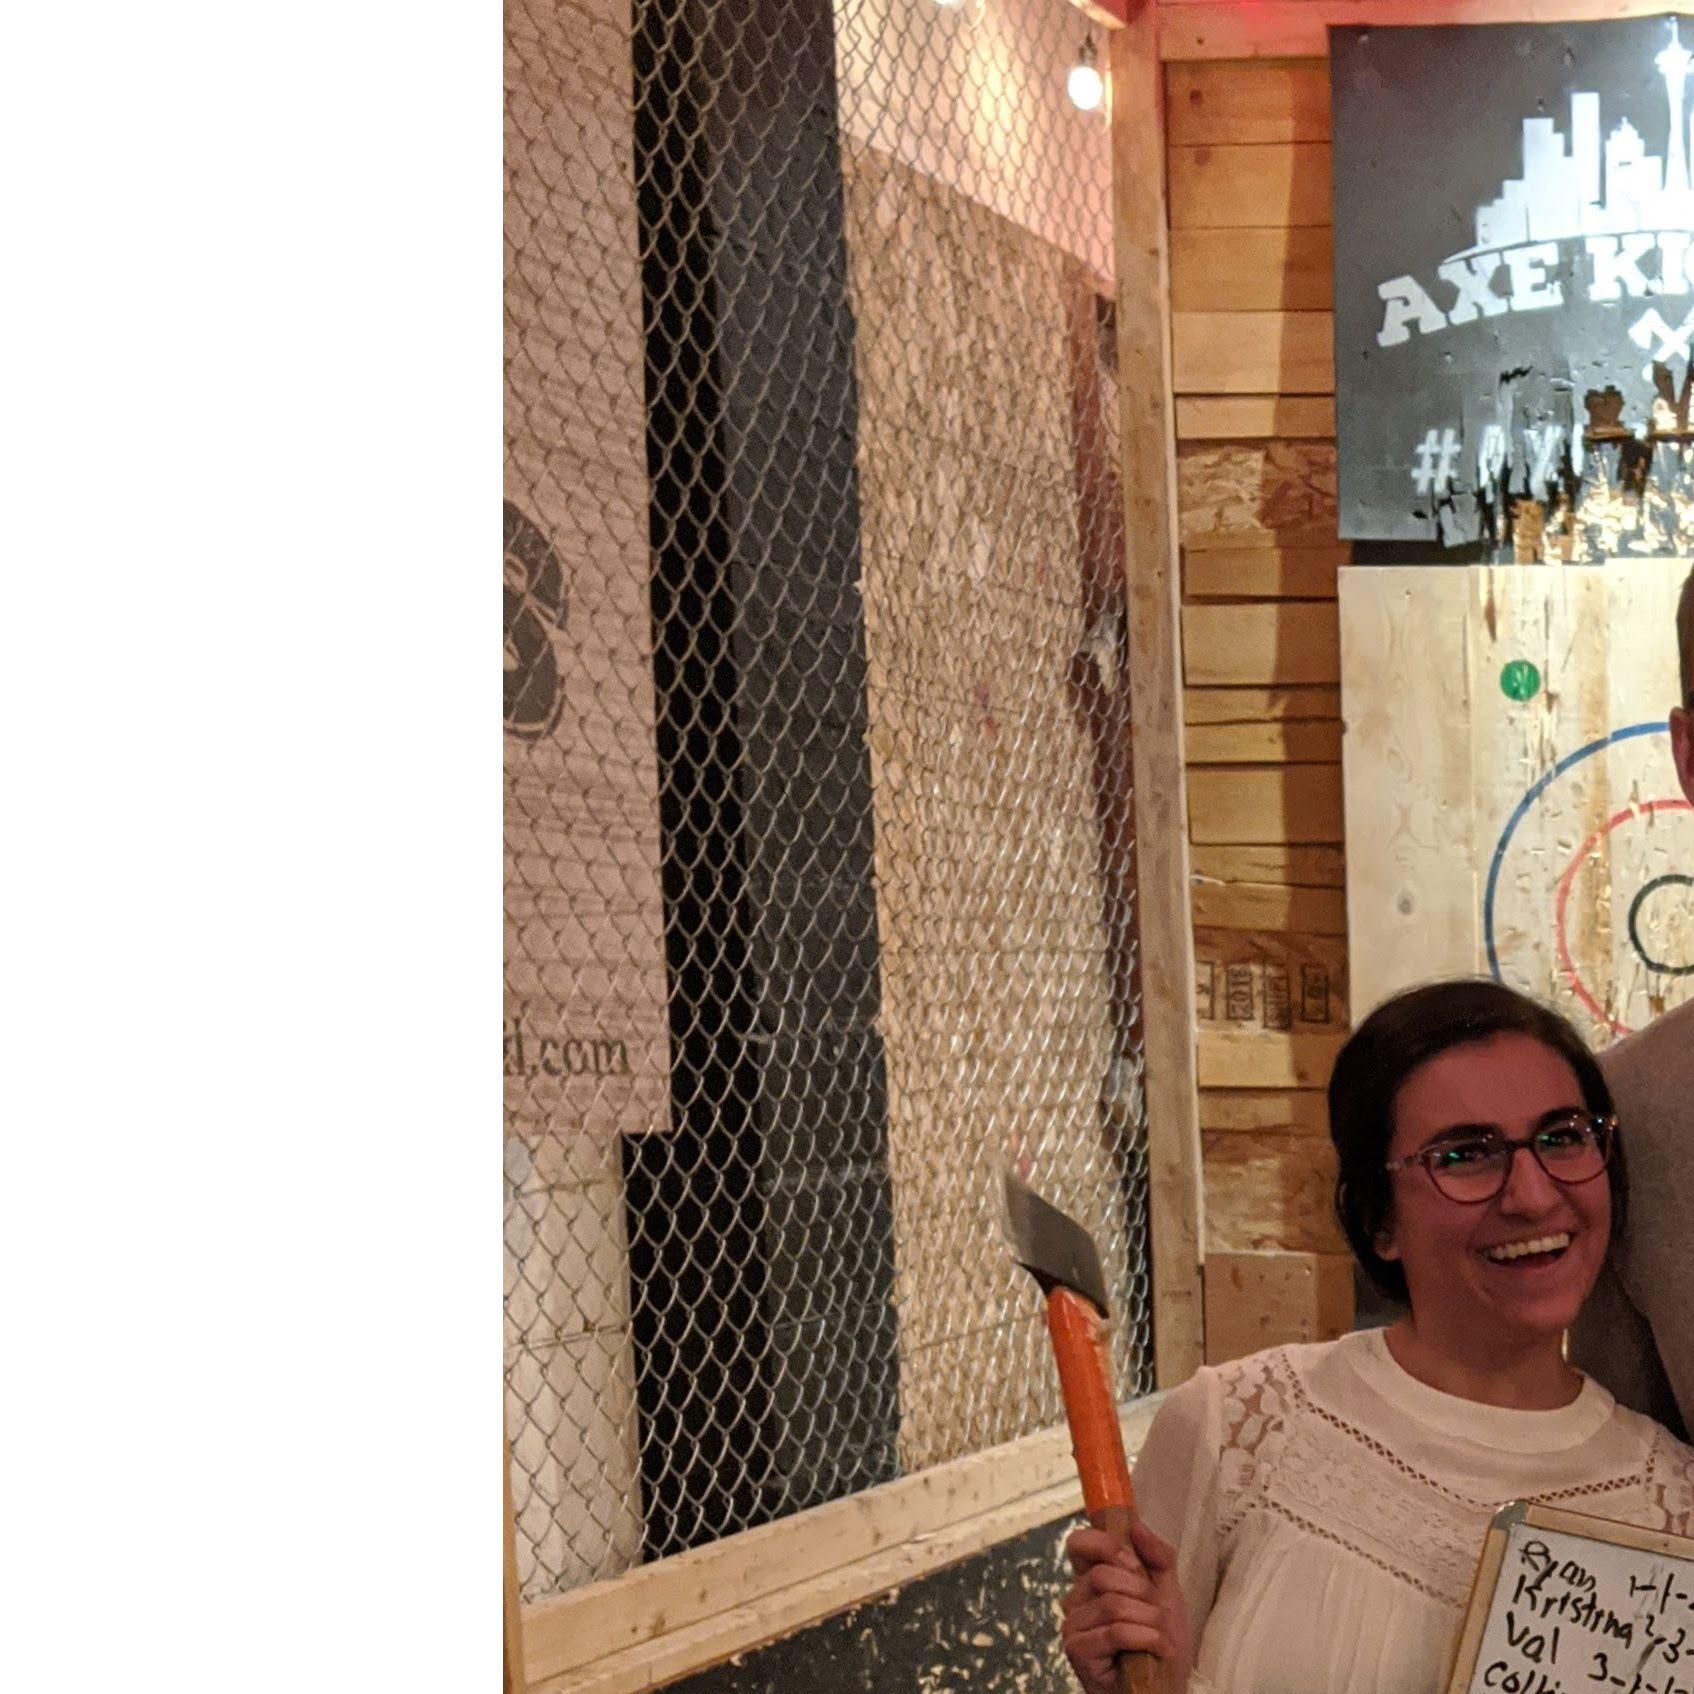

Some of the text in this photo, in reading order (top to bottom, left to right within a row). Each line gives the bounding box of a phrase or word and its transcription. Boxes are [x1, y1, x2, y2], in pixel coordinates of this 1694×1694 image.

[1377, 242, 1563, 347] AXE
[1519, 1540, 1597, 1593] Ryan
[1506, 1610, 1560, 1664] Val
[1512, 1573, 1633, 1649] Kristina
